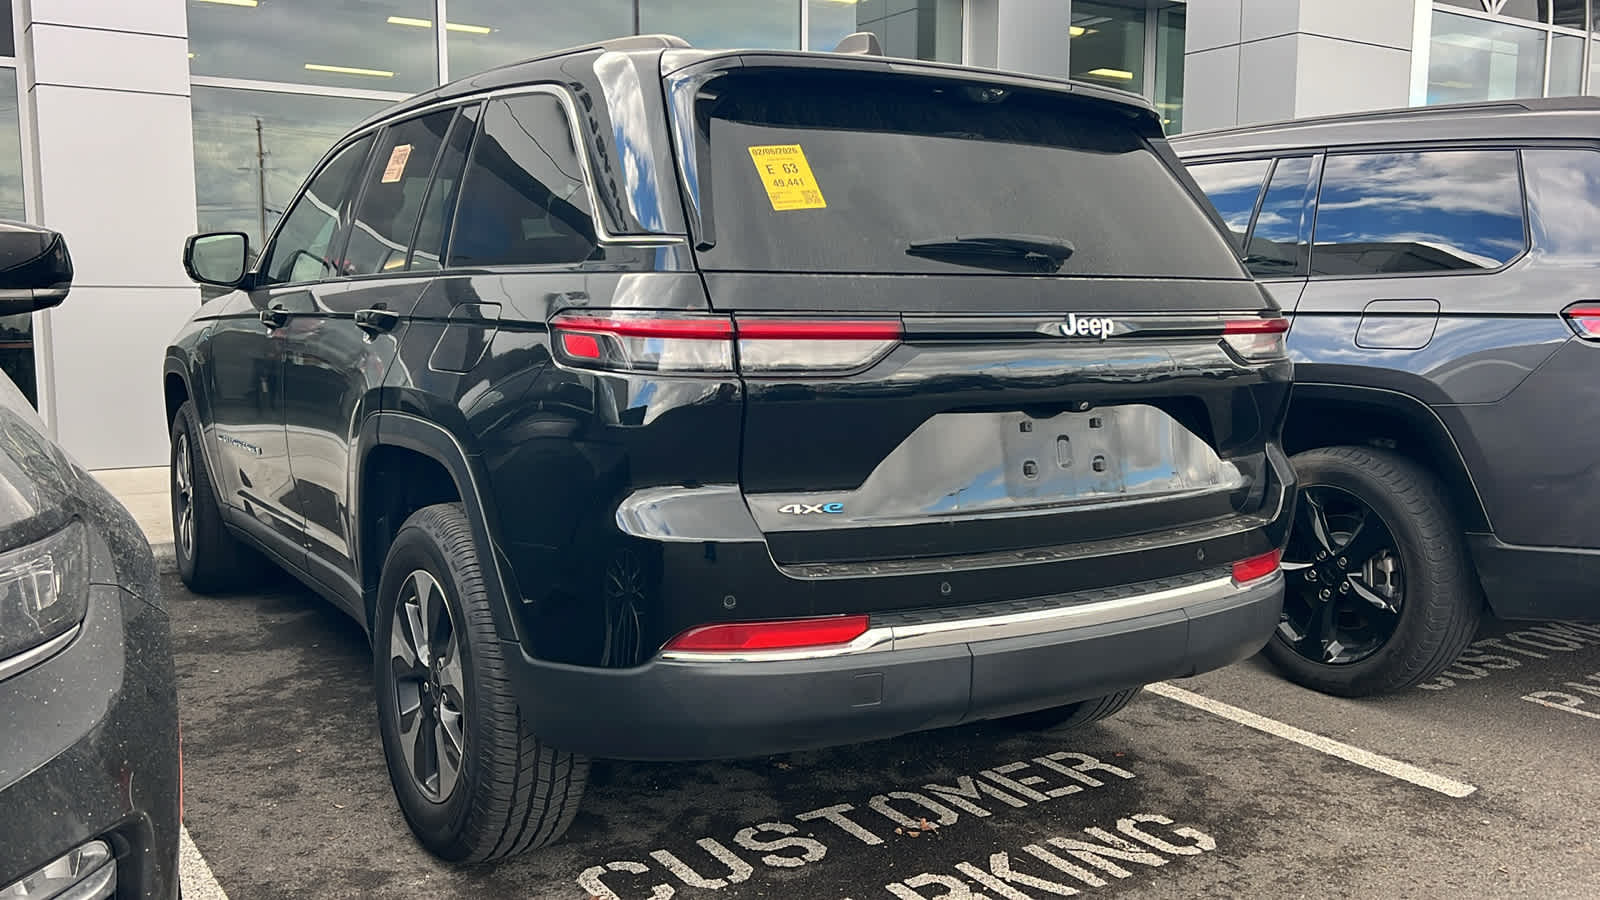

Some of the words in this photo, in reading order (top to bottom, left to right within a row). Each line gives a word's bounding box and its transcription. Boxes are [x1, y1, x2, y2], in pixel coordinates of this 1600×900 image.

[766, 164, 776, 175] E
[782, 163, 799, 174] 63
[1060, 313, 1114, 339] Jeep
[577, 750, 1136, 900] CUSTOMER
